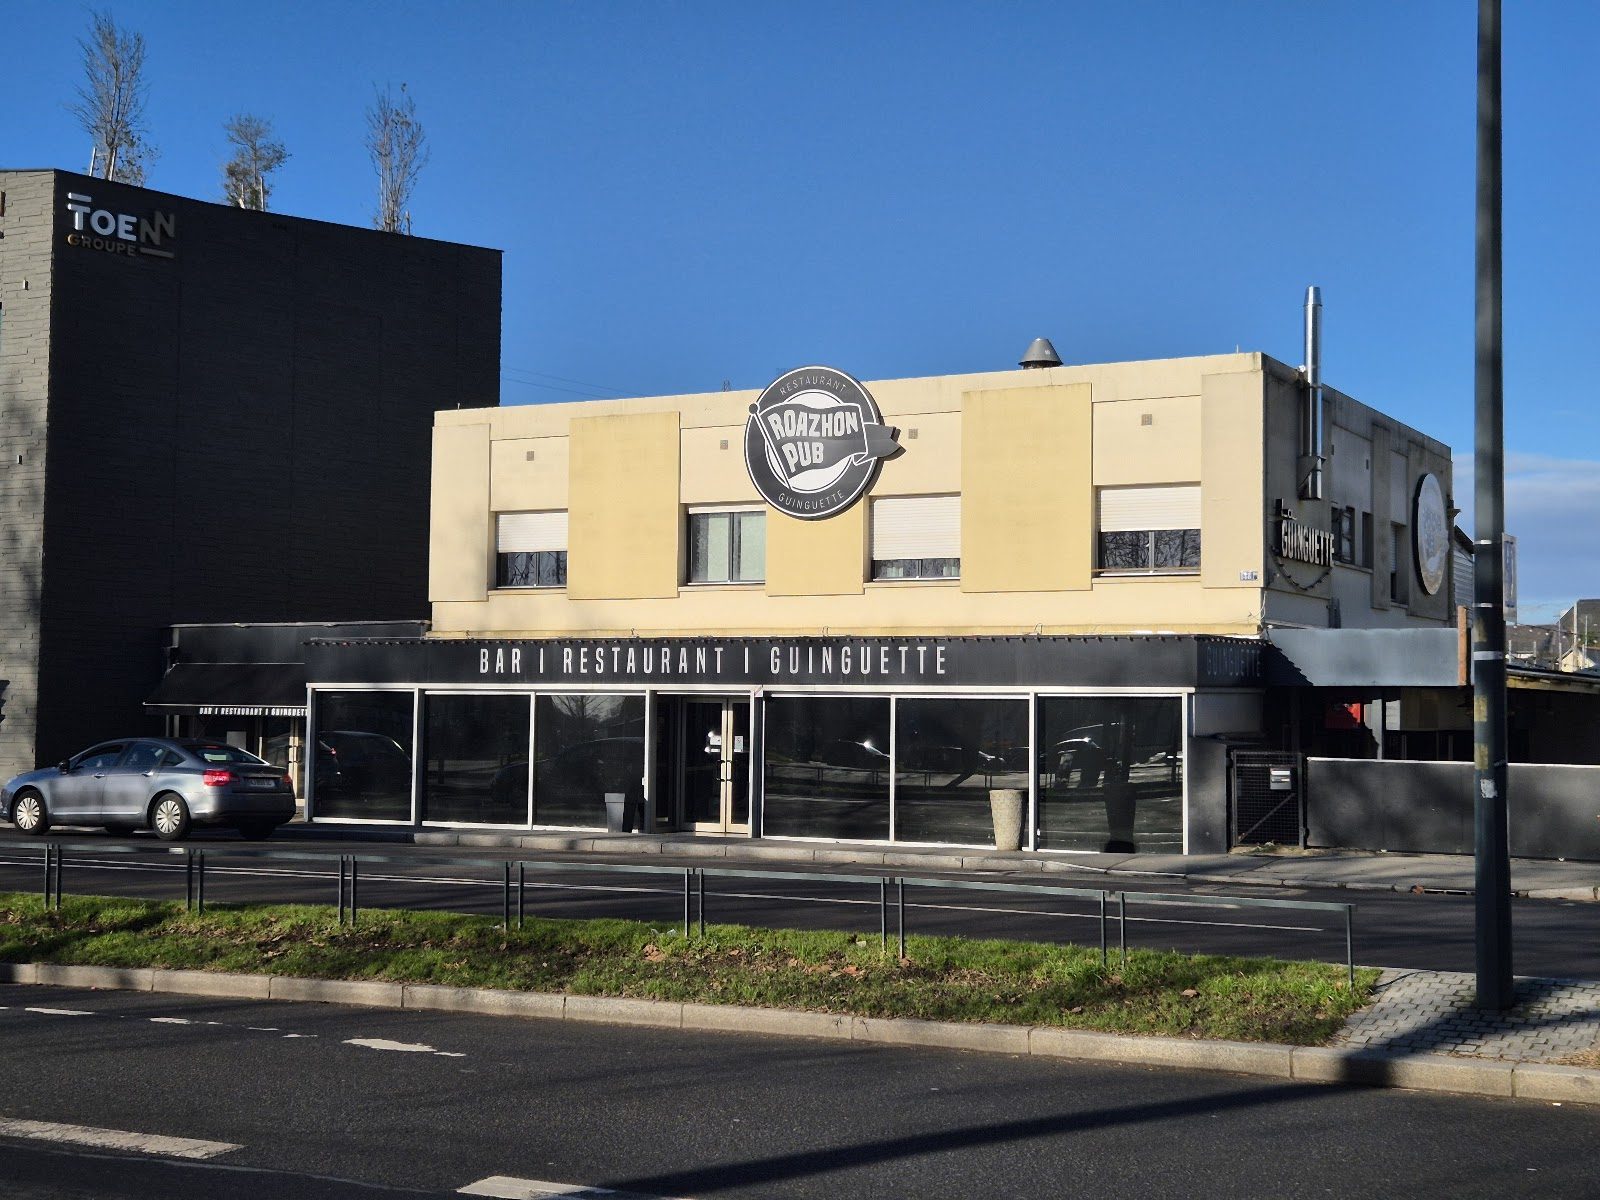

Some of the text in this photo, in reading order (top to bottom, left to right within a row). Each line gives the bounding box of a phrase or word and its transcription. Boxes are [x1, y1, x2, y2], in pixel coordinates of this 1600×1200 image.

[67, 192, 175, 247] TOENN
[67, 233, 137, 257] GROUPE
[779, 375, 847, 396] RESTAURANT
[767, 409, 859, 441] ROAZHON
[782, 441, 825, 474] PUB
[778, 489, 845, 511] GUINGUETTE
[1281, 519, 1335, 568] GUINGUETTE
[479, 648, 522, 674] BAR
[563, 647, 722, 674] RESTAURANT
[770, 646, 946, 675] GUINGUETTE
[221, 707, 263, 716] RESTAURANT
